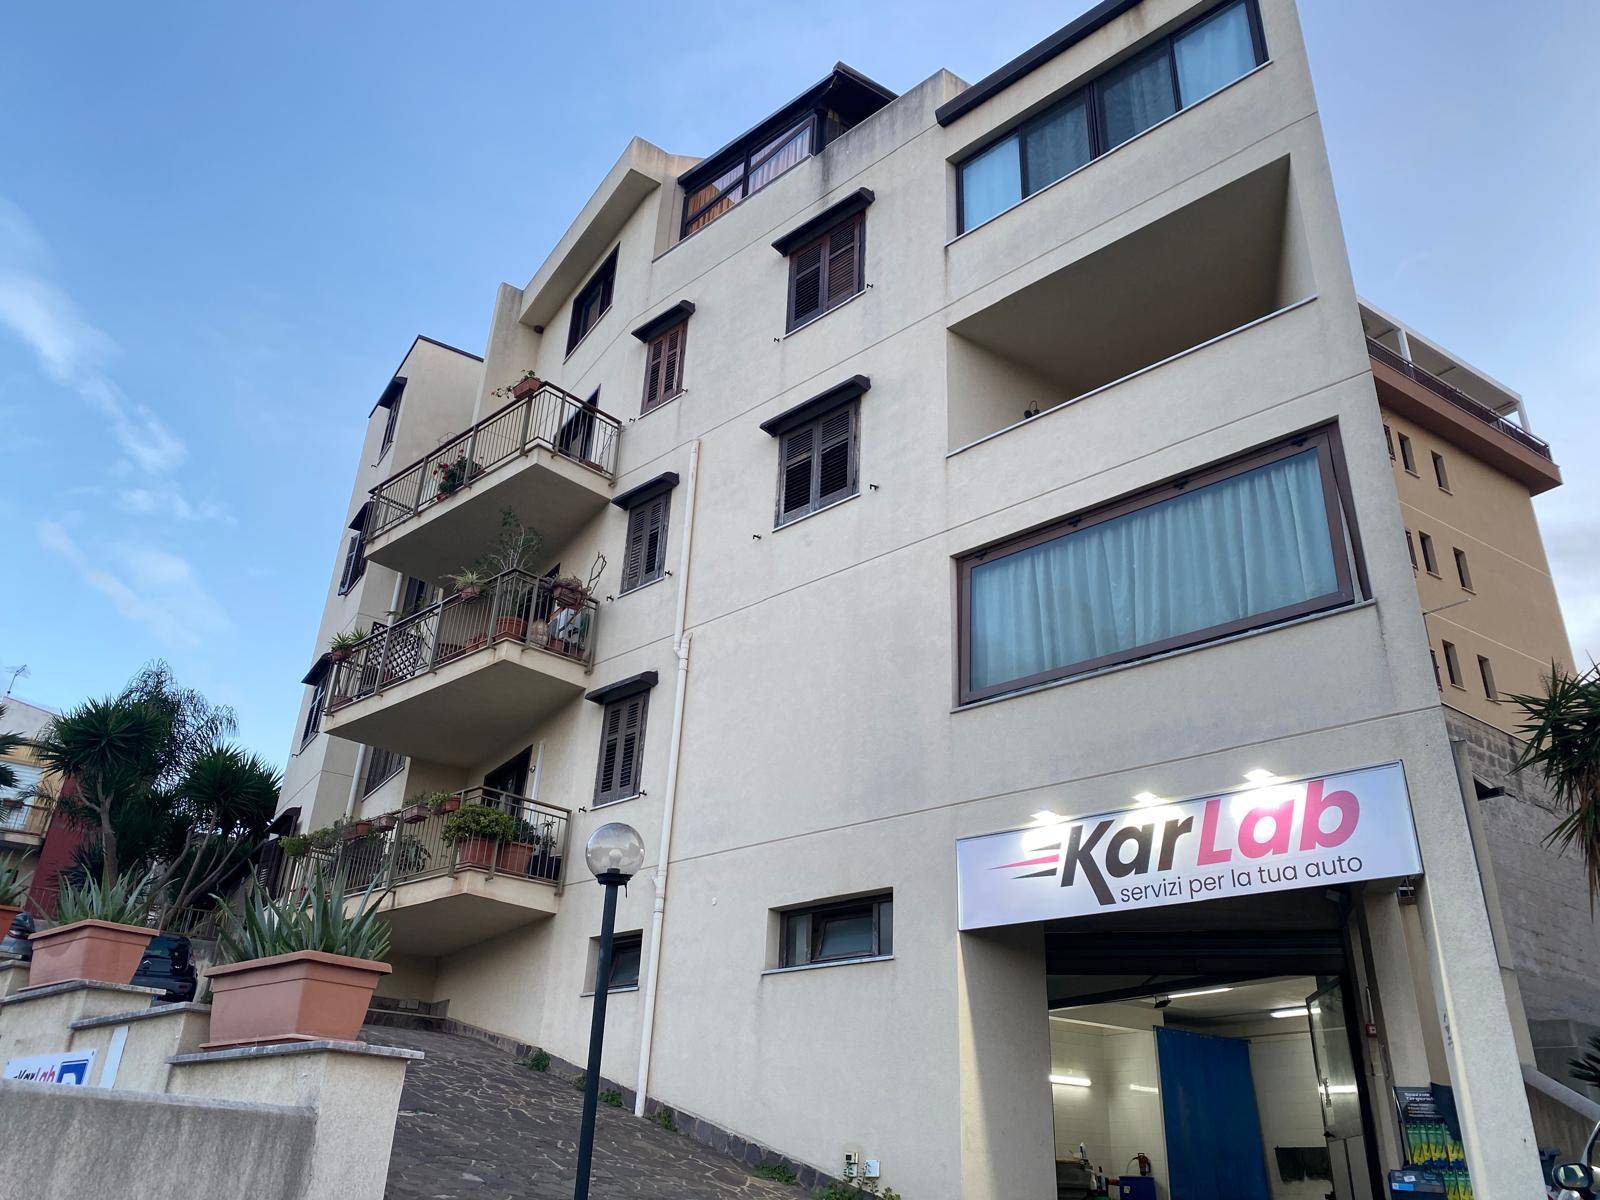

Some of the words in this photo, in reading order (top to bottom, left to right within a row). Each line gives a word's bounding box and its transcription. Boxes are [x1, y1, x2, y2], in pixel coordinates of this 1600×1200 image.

[1120, 876, 1182, 903] servizi
[1189, 874, 1225, 899] per
[1231, 869, 1252, 888] la
[1258, 865, 1297, 884] tua
[1305, 855, 1363, 878] auto
